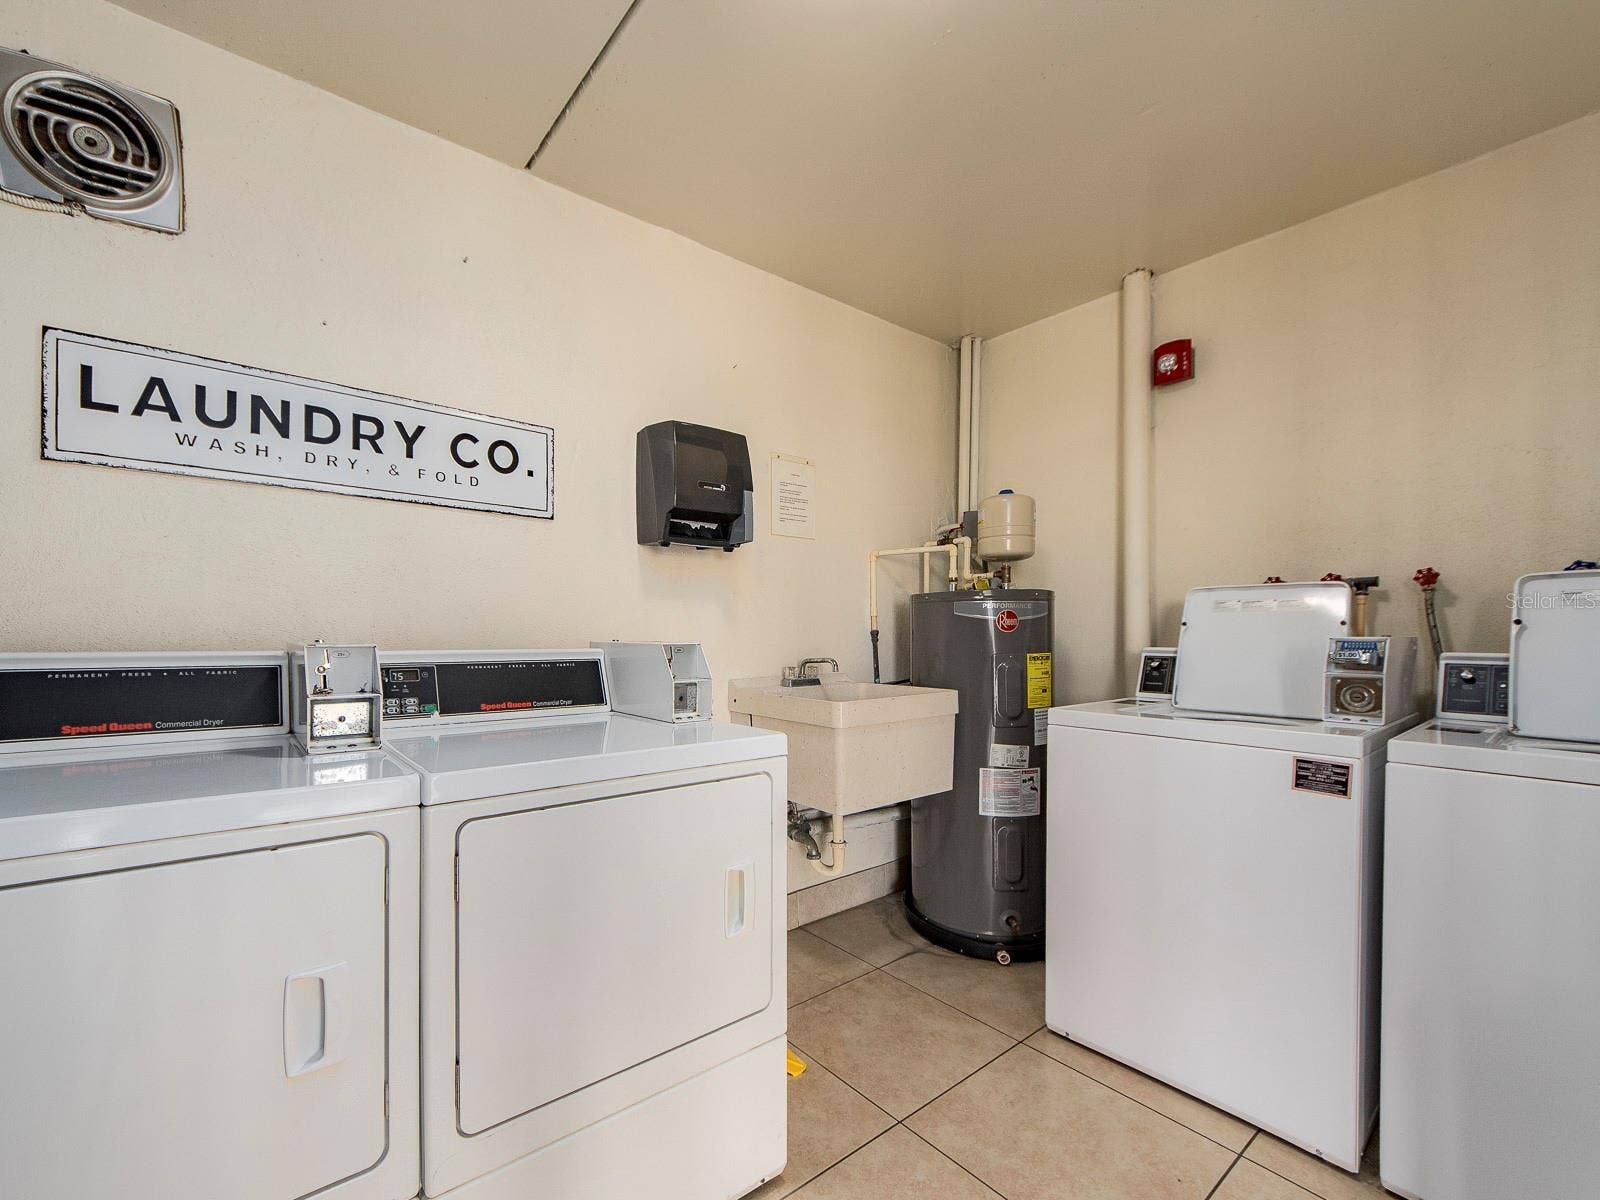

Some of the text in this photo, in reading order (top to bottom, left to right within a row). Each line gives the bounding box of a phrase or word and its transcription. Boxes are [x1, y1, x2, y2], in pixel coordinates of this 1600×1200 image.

[79, 363, 536, 478] LAUNDRY CO.
[174, 432, 481, 488] WASH, DRY, & FOLD
[480, 702, 506, 711] Speed
[61, 718, 224, 735] Speed Queen Commercial Dryer
